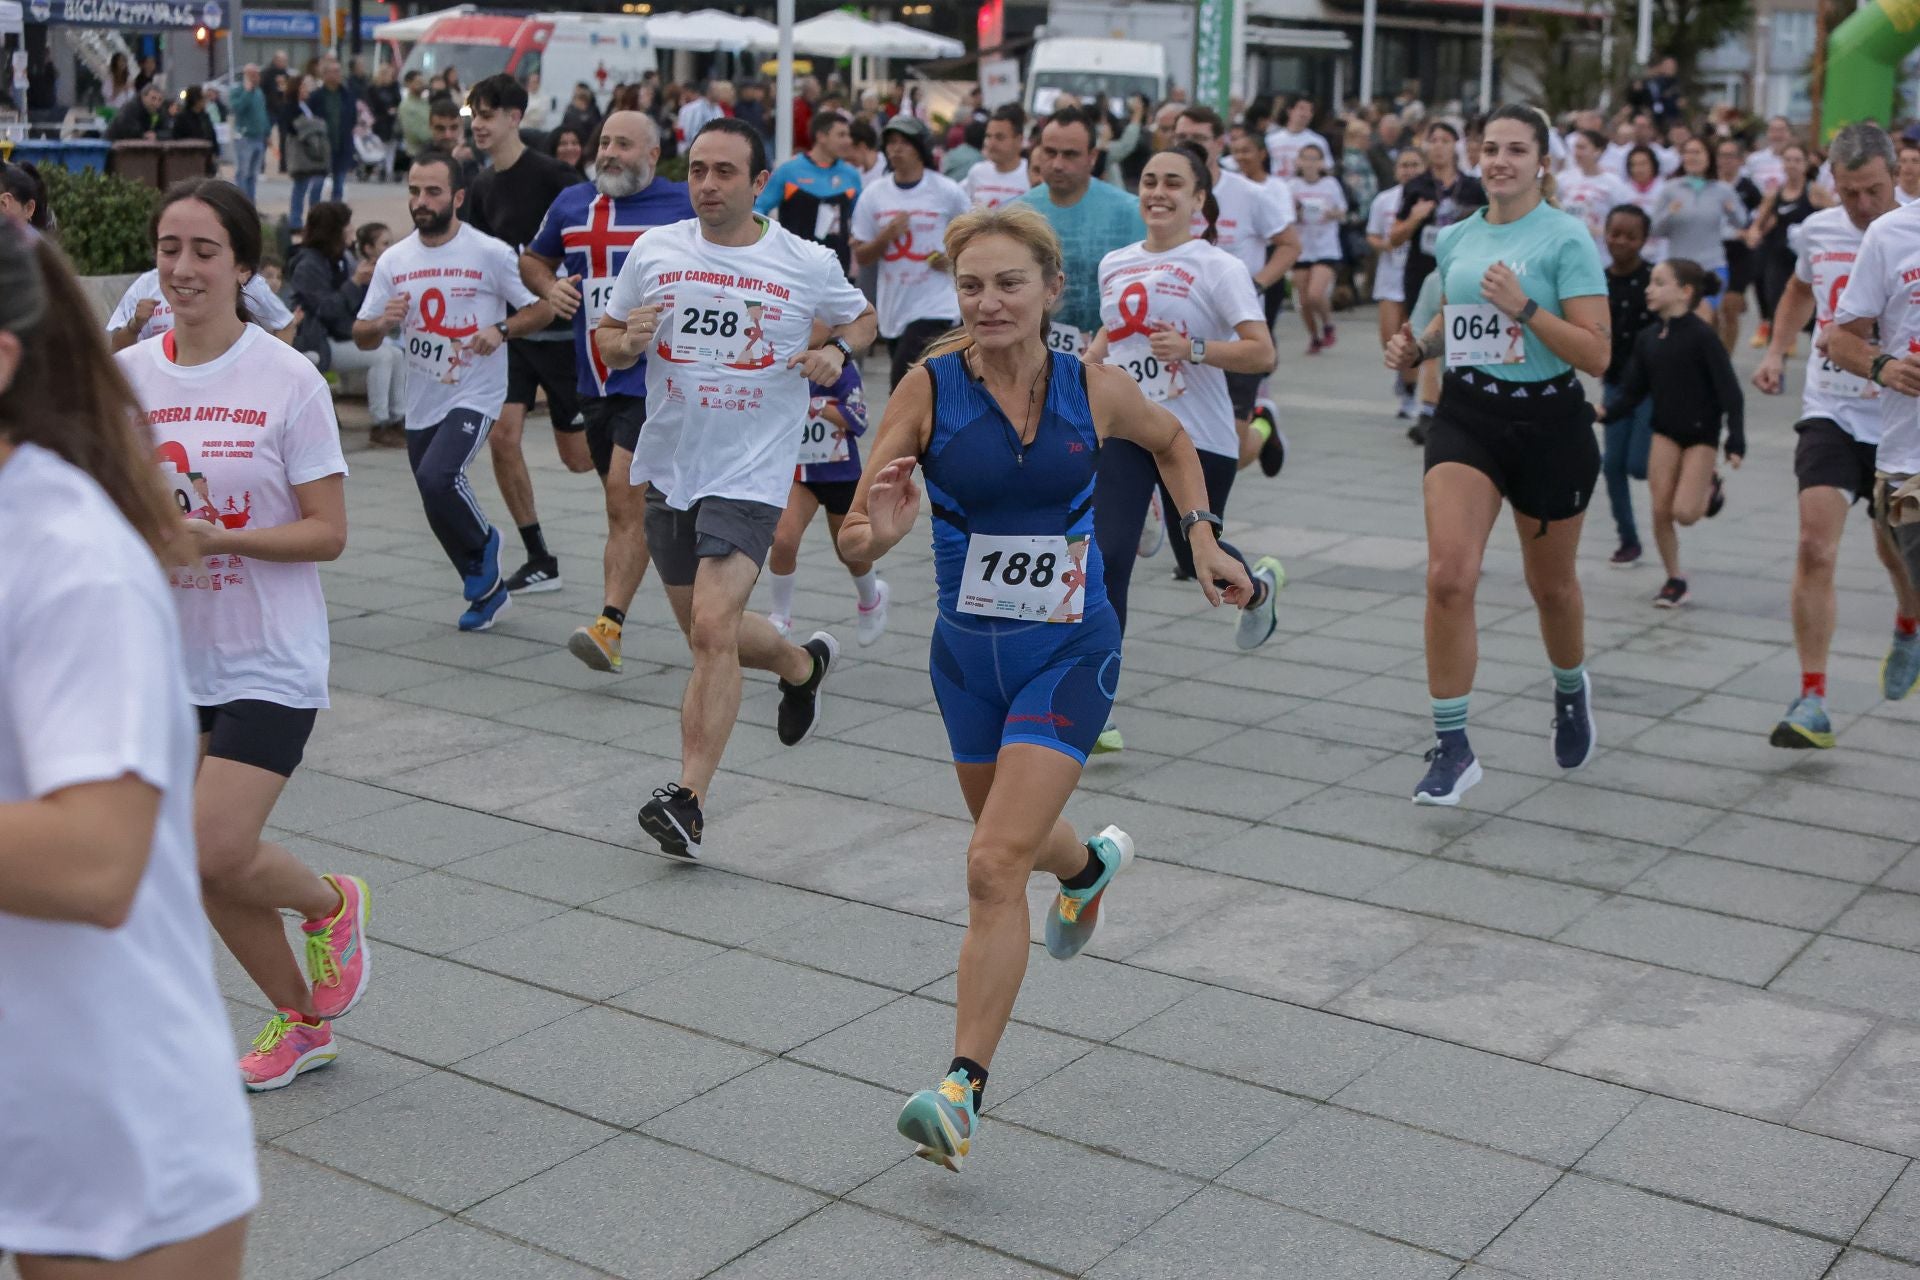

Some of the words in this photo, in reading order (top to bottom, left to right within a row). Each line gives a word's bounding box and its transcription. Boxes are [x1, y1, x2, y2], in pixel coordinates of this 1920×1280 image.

[408, 267, 441, 281] CARRERA
[443, 267, 483, 281] ANTI-SIDA
[657, 270, 683, 286] XXIV
[685, 270, 734, 287] CARRERA
[737, 276, 791, 301] ANTI-SIDA
[681, 307, 739, 338] 258
[1453, 313, 1501, 341] 064
[410, 337, 444, 362] 091
[194, 406, 267, 428] ANTI-SIDA
[201, 450, 210, 458] DE
[211, 450, 224, 458] SAN
[226, 451, 254, 459] LORENZO
[223, 440, 234, 448] DEL
[236, 440, 255, 448] MURO
[980, 550, 1057, 588] 188
